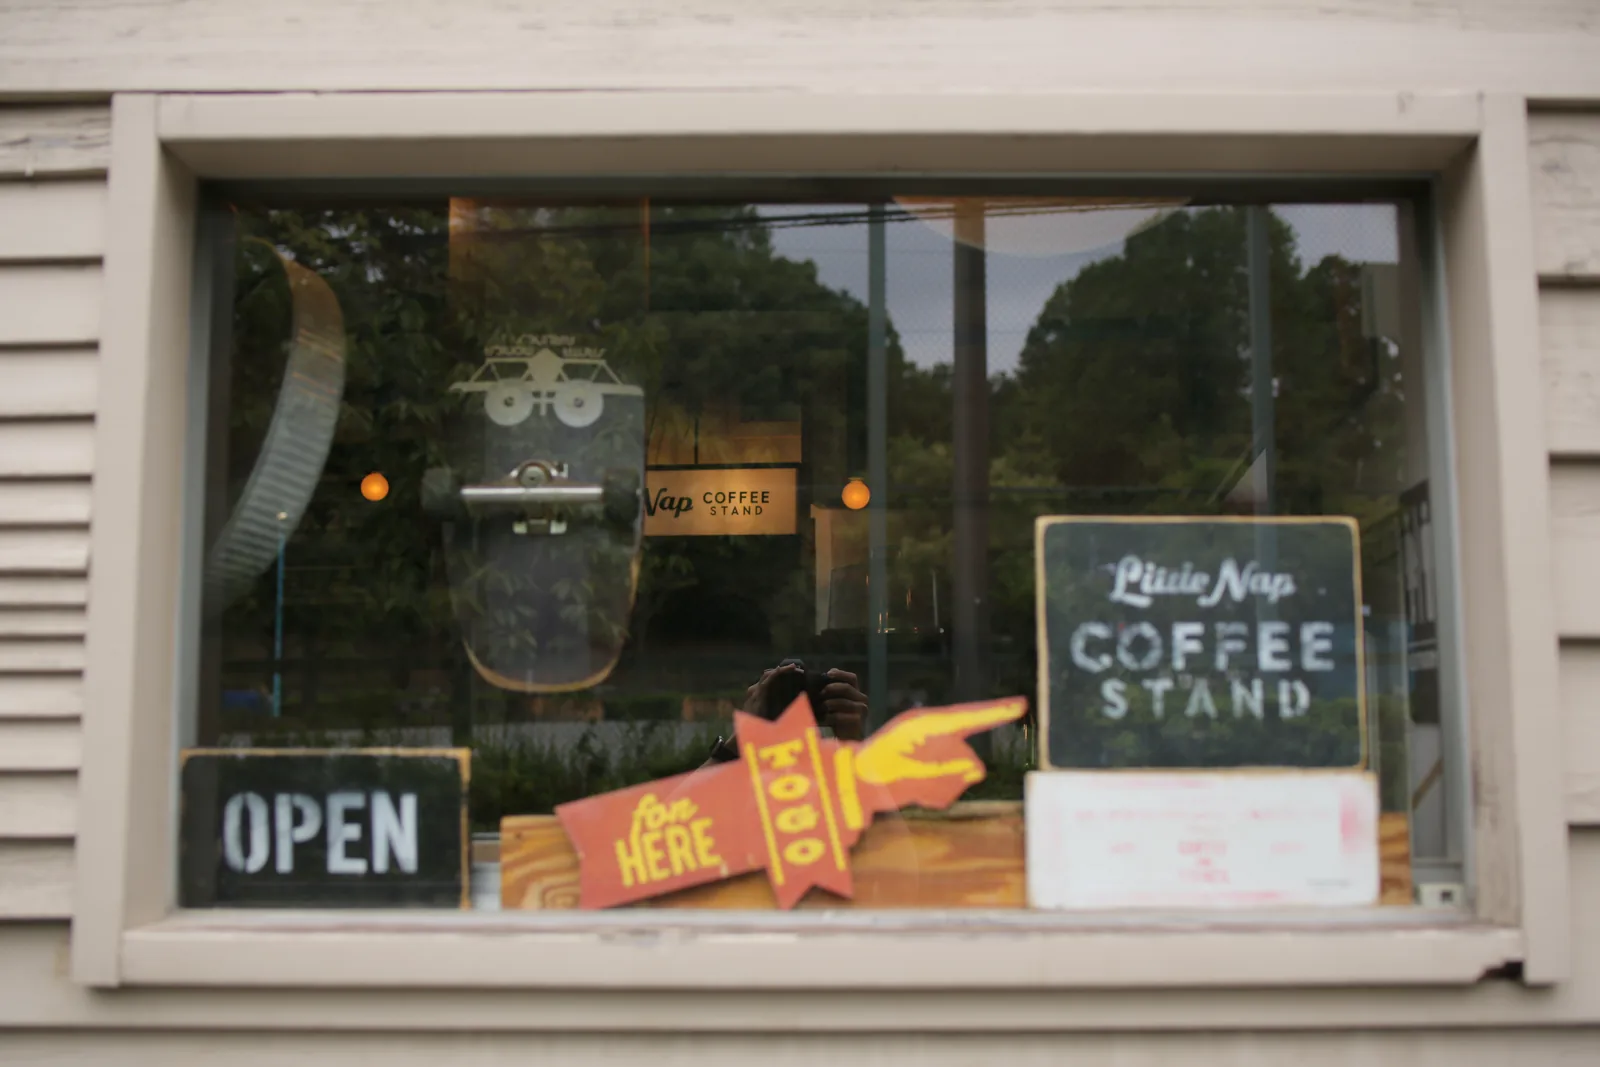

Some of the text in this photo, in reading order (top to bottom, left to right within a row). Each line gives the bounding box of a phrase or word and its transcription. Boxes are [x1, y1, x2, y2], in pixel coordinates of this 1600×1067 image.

[703, 491, 770, 504] COFFEE
[710, 505, 763, 516] STAND
[1197, 557, 1296, 607] Nap
[1070, 621, 1335, 673] COFFEE
[1099, 677, 1311, 720] STAND
[223, 791, 418, 874] OPEN
[614, 817, 722, 887] HERE
